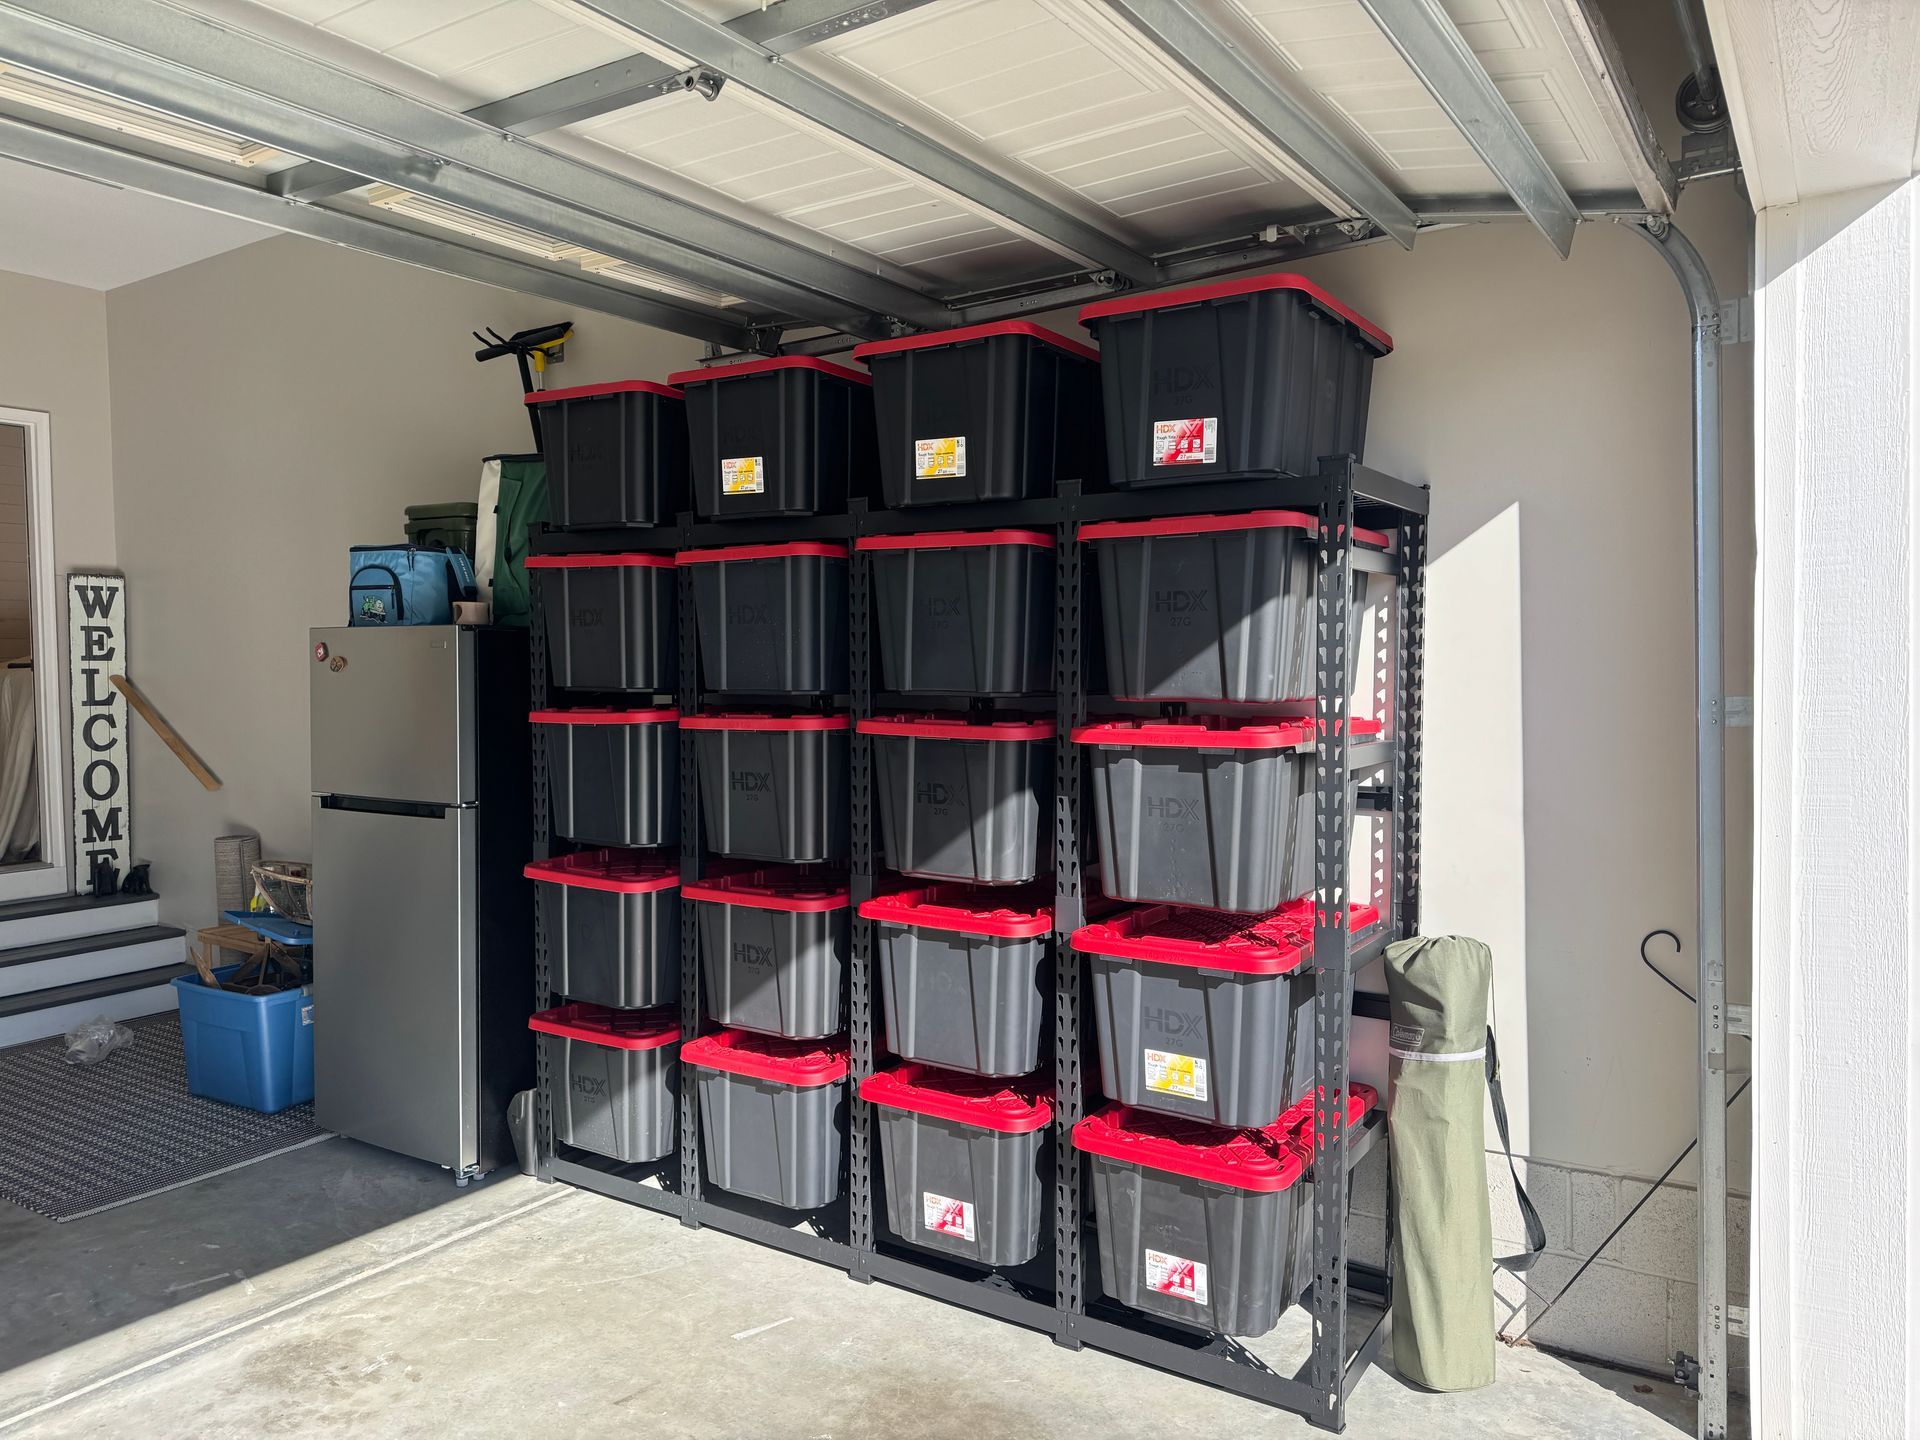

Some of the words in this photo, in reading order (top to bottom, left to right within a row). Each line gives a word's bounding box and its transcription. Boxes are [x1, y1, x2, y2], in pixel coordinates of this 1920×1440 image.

[1153, 363, 1215, 395] HDX
[1156, 423, 1176, 434] HDX
[917, 442, 934, 452] HDX
[1154, 589, 1209, 613] HDX
[569, 607, 605, 628] HDX
[728, 603, 768, 625] HDX
[1168, 616, 1191, 628] 27G
[730, 770, 771, 793] HDX
[915, 782, 965, 807] HDX
[933, 807, 949, 817] 27G
[1146, 795, 1200, 822] HDX
[733, 942, 773, 968] HDX
[1144, 1005, 1204, 1040] HDX
[1165, 1037, 1184, 1048] 27G
[1147, 1052, 1167, 1064] HDX
[571, 1072, 607, 1097] HDX
[1148, 1252, 1168, 1266] HDX
